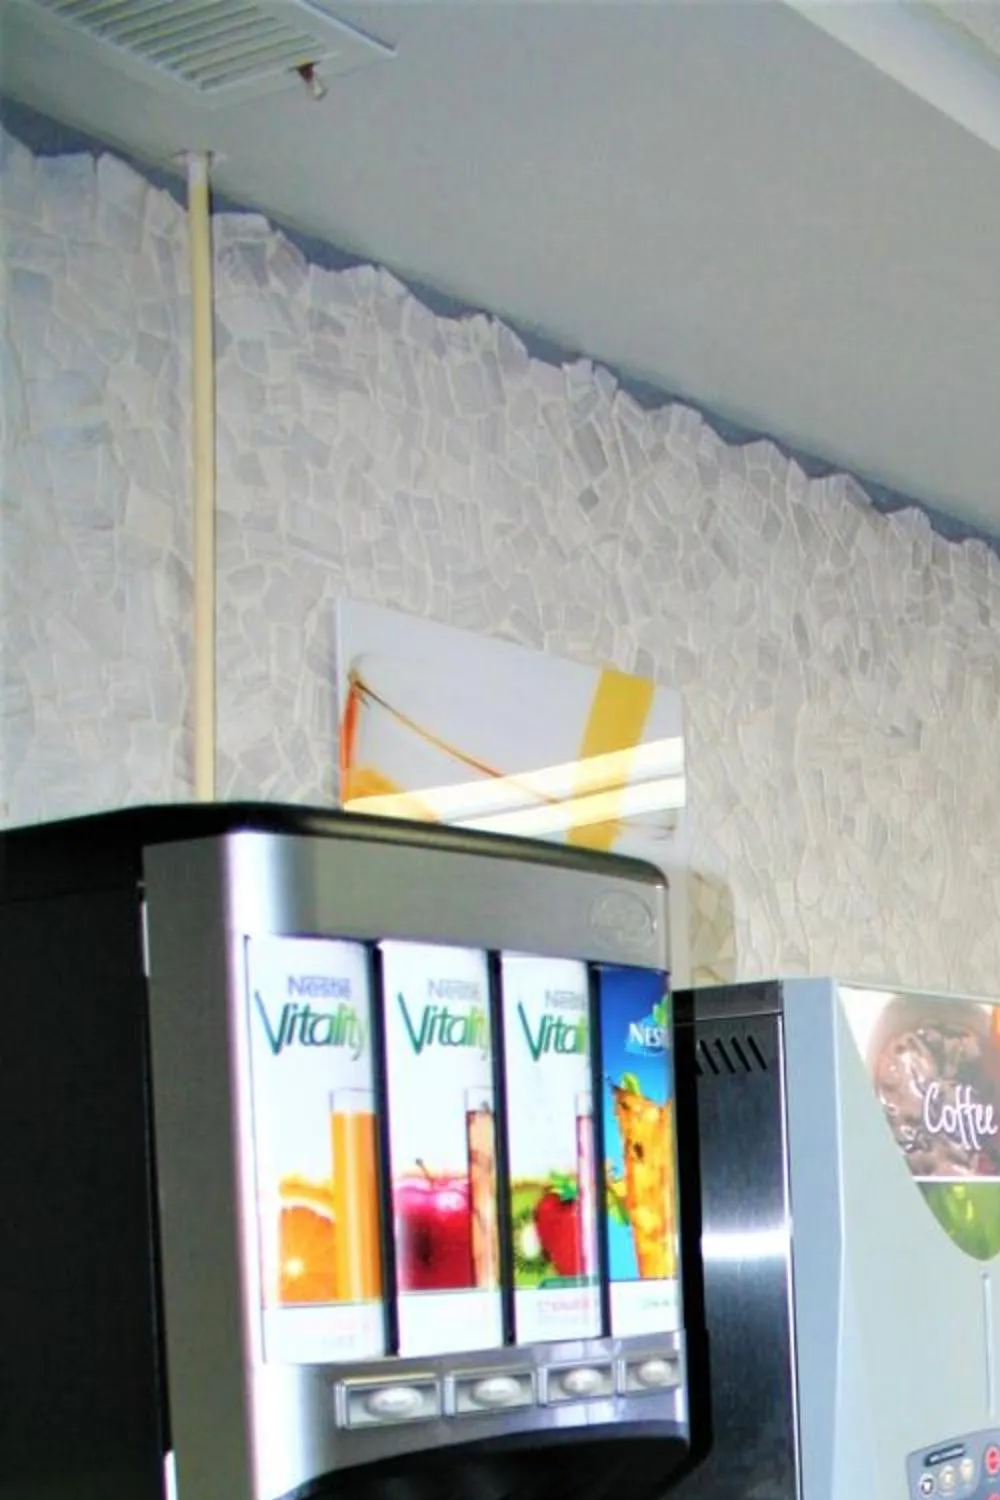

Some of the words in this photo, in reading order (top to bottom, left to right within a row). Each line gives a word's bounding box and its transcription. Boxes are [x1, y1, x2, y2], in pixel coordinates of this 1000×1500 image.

[517, 1000, 589, 1062] Vital
[629, 1022, 671, 1049] NES
[923, 1082, 998, 1150] Coffee
